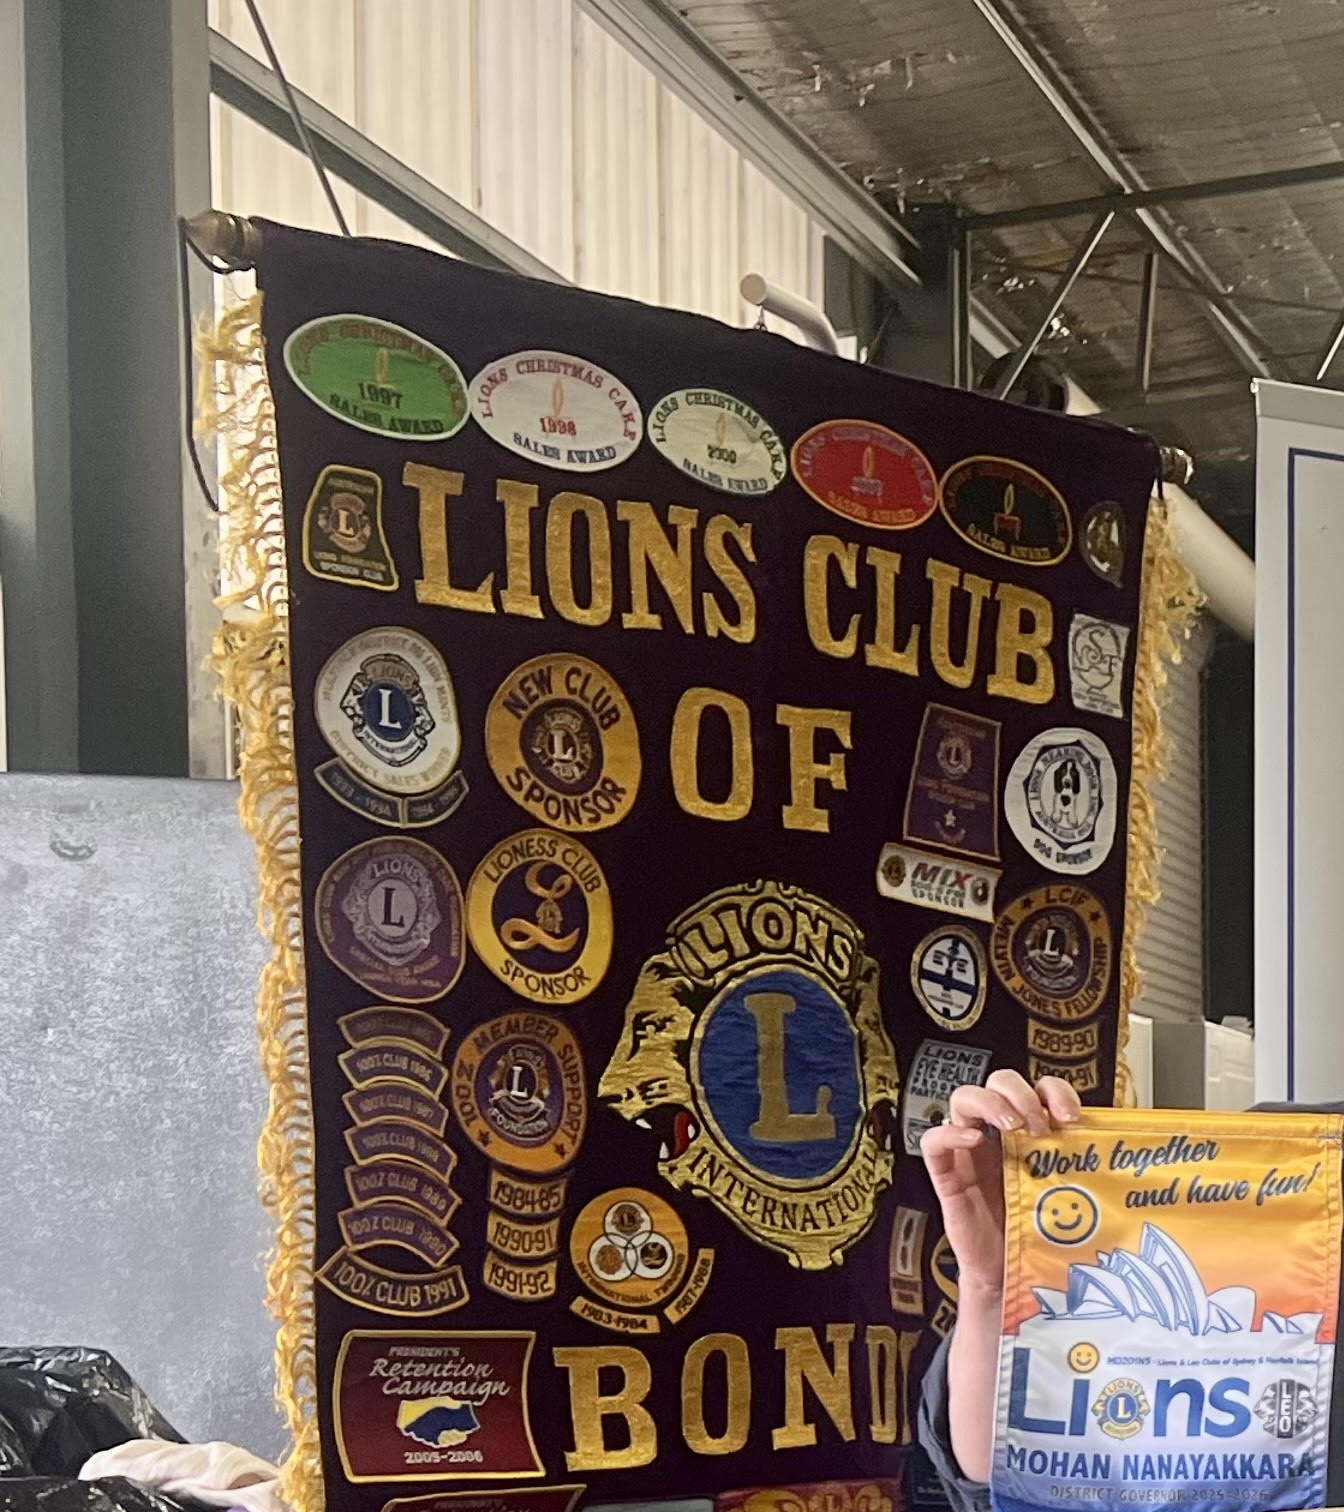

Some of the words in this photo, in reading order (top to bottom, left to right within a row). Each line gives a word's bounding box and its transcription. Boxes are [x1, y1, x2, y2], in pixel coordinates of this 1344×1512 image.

[478, 368, 508, 419] LIONS
[516, 359, 604, 388] CHRISTMAS
[608, 388, 636, 440] CAKE
[653, 397, 679, 443] LIONS
[686, 392, 759, 428] CHRISTMAS
[539, 417, 576, 435] 1998
[513, 432, 561, 460] SALES
[566, 446, 616, 463] AWARD
[402, 461, 758, 643] LIONS
[803, 534, 1055, 705] CLUB
[502, 666, 552, 720] NEW
[565, 667, 621, 732] CLUB
[670, 686, 853, 833] OF
[506, 766, 627, 826] SPONSOR
[372, 860, 422, 882] LIONS
[481, 837, 558, 883] LIONESS
[562, 843, 600, 894] CLUB
[912, 862, 973, 889] MIX
[1044, 888, 1088, 904] LCIF
[678, 901, 853, 980] LIONS
[500, 959, 592, 997] SPONSOR
[1013, 984, 1058, 1015] JONES
[1066, 939, 1108, 1014] FELLOWSHIP
[743, 992, 837, 1143] L
[924, 1046, 984, 1066] LIONS
[472, 1016, 559, 1050] MEMBER
[557, 1044, 582, 1145] SUPPORT
[1026, 1144, 1101, 1180] Work
[1109, 1135, 1221, 1177] together
[388, 1172, 417, 1191] CLUB
[688, 1148, 878, 1234] INTERNATIONAL
[1125, 1177, 1180, 1208] and
[1187, 1175, 1250, 1204] have
[1256, 1162, 1321, 1206] fun!
[382, 1215, 415, 1235] CLUB
[492, 1221, 550, 1252] 1990-91
[375, 1283, 422, 1306] CLUB
[423, 1280, 457, 1304] 1991
[487, 1262, 552, 1295] 1991-92
[368, 1357, 494, 1379] Retention
[382, 1376, 511, 1406] Campaign
[1107, 1380, 1142, 1397] LIONS
[1280, 1379, 1292, 1432] LEO
[1007, 1445, 1111, 1480] MOHAN
[1122, 1453, 1316, 1481] NANAYAKKARA
[1051, 1486, 1113, 1499] DISTRICT
[1120, 1489, 1184, 1501] GOVERNOR
